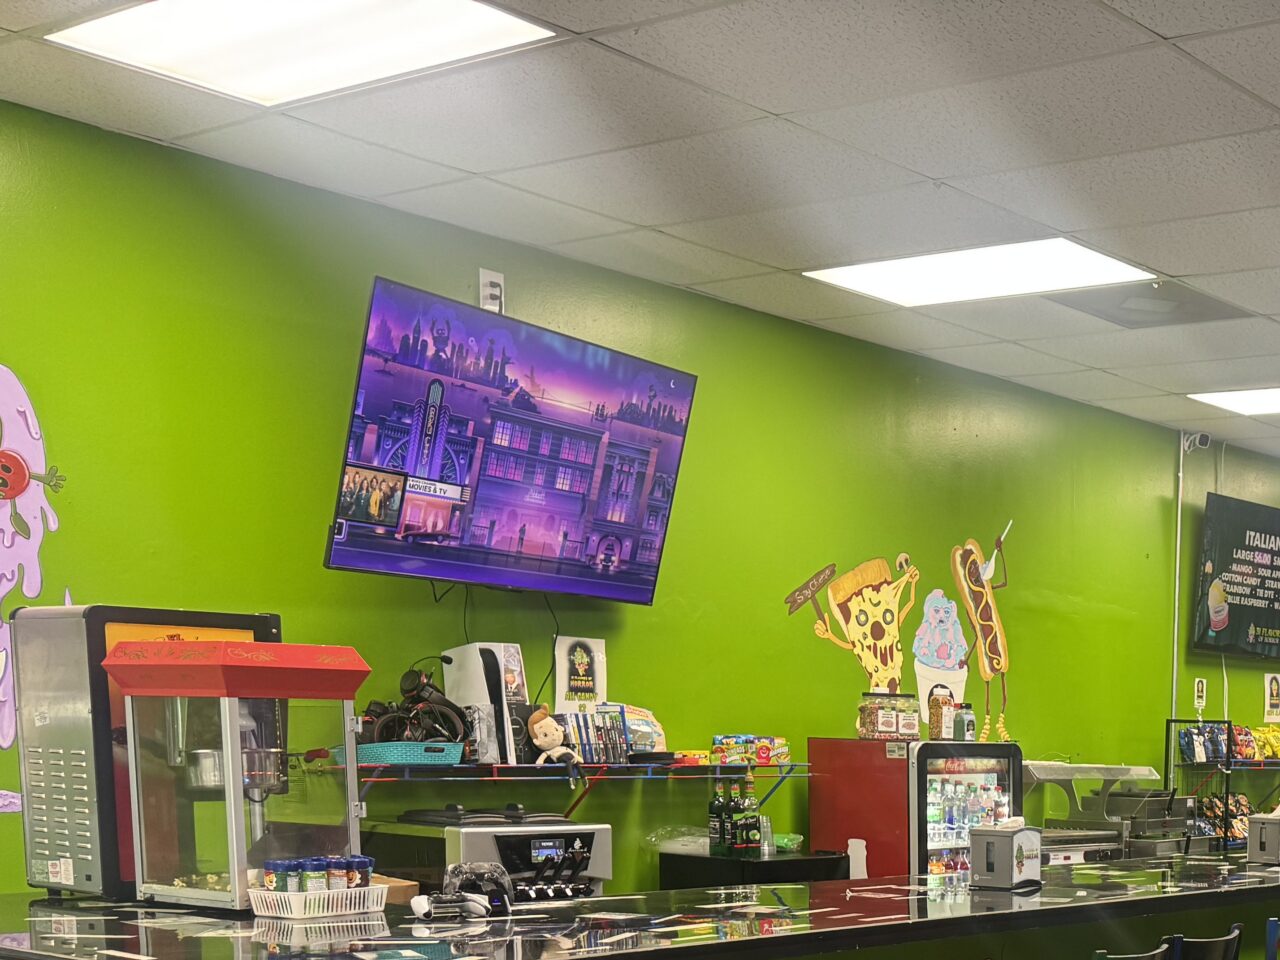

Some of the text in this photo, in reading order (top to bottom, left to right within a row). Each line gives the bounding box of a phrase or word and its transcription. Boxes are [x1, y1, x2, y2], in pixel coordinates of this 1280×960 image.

[409, 482, 432, 493] MOVIES
[439, 487, 448, 496] TV
[1233, 548, 1254, 562] LARGE
[1254, 551, 1271, 565] $6.00
[1232, 563, 1253, 574] MANGO
[1258, 567, 1271, 577] SOUR
[1221, 572, 1243, 583] COTTON
[1243, 576, 1261, 587] CANDY
[795, 589, 811, 603] Say
[1226, 585, 1251, 595] RAINBOW
[1256, 588, 1265, 597] TIE
[1265, 590, 1274, 599] DYE
[1227, 595, 1241, 604] BLUE
[1241, 597, 1269, 608] RASPBERRY
[577, 692, 598, 702] CANDY
